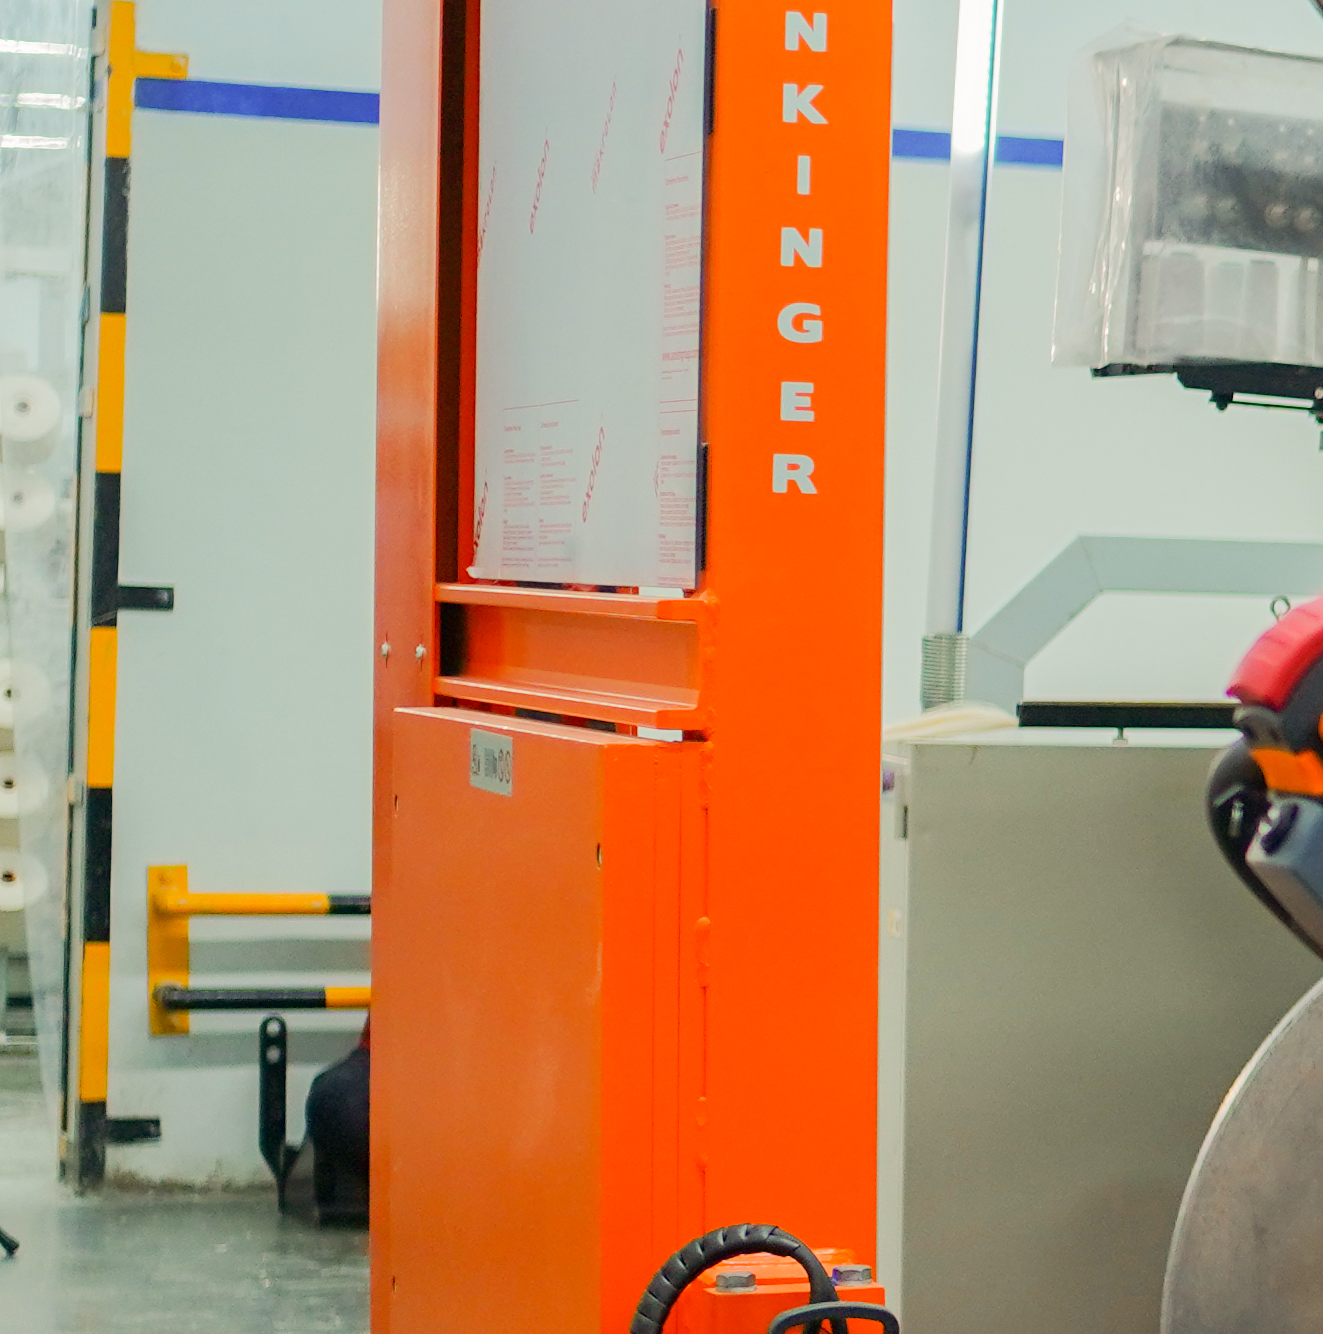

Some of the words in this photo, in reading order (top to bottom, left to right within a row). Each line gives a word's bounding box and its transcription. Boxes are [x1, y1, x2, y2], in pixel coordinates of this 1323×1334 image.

[659, 49, 684, 154] exolon
[529, 139, 550, 234] exolon
[581, 426, 605, 523] exolon
